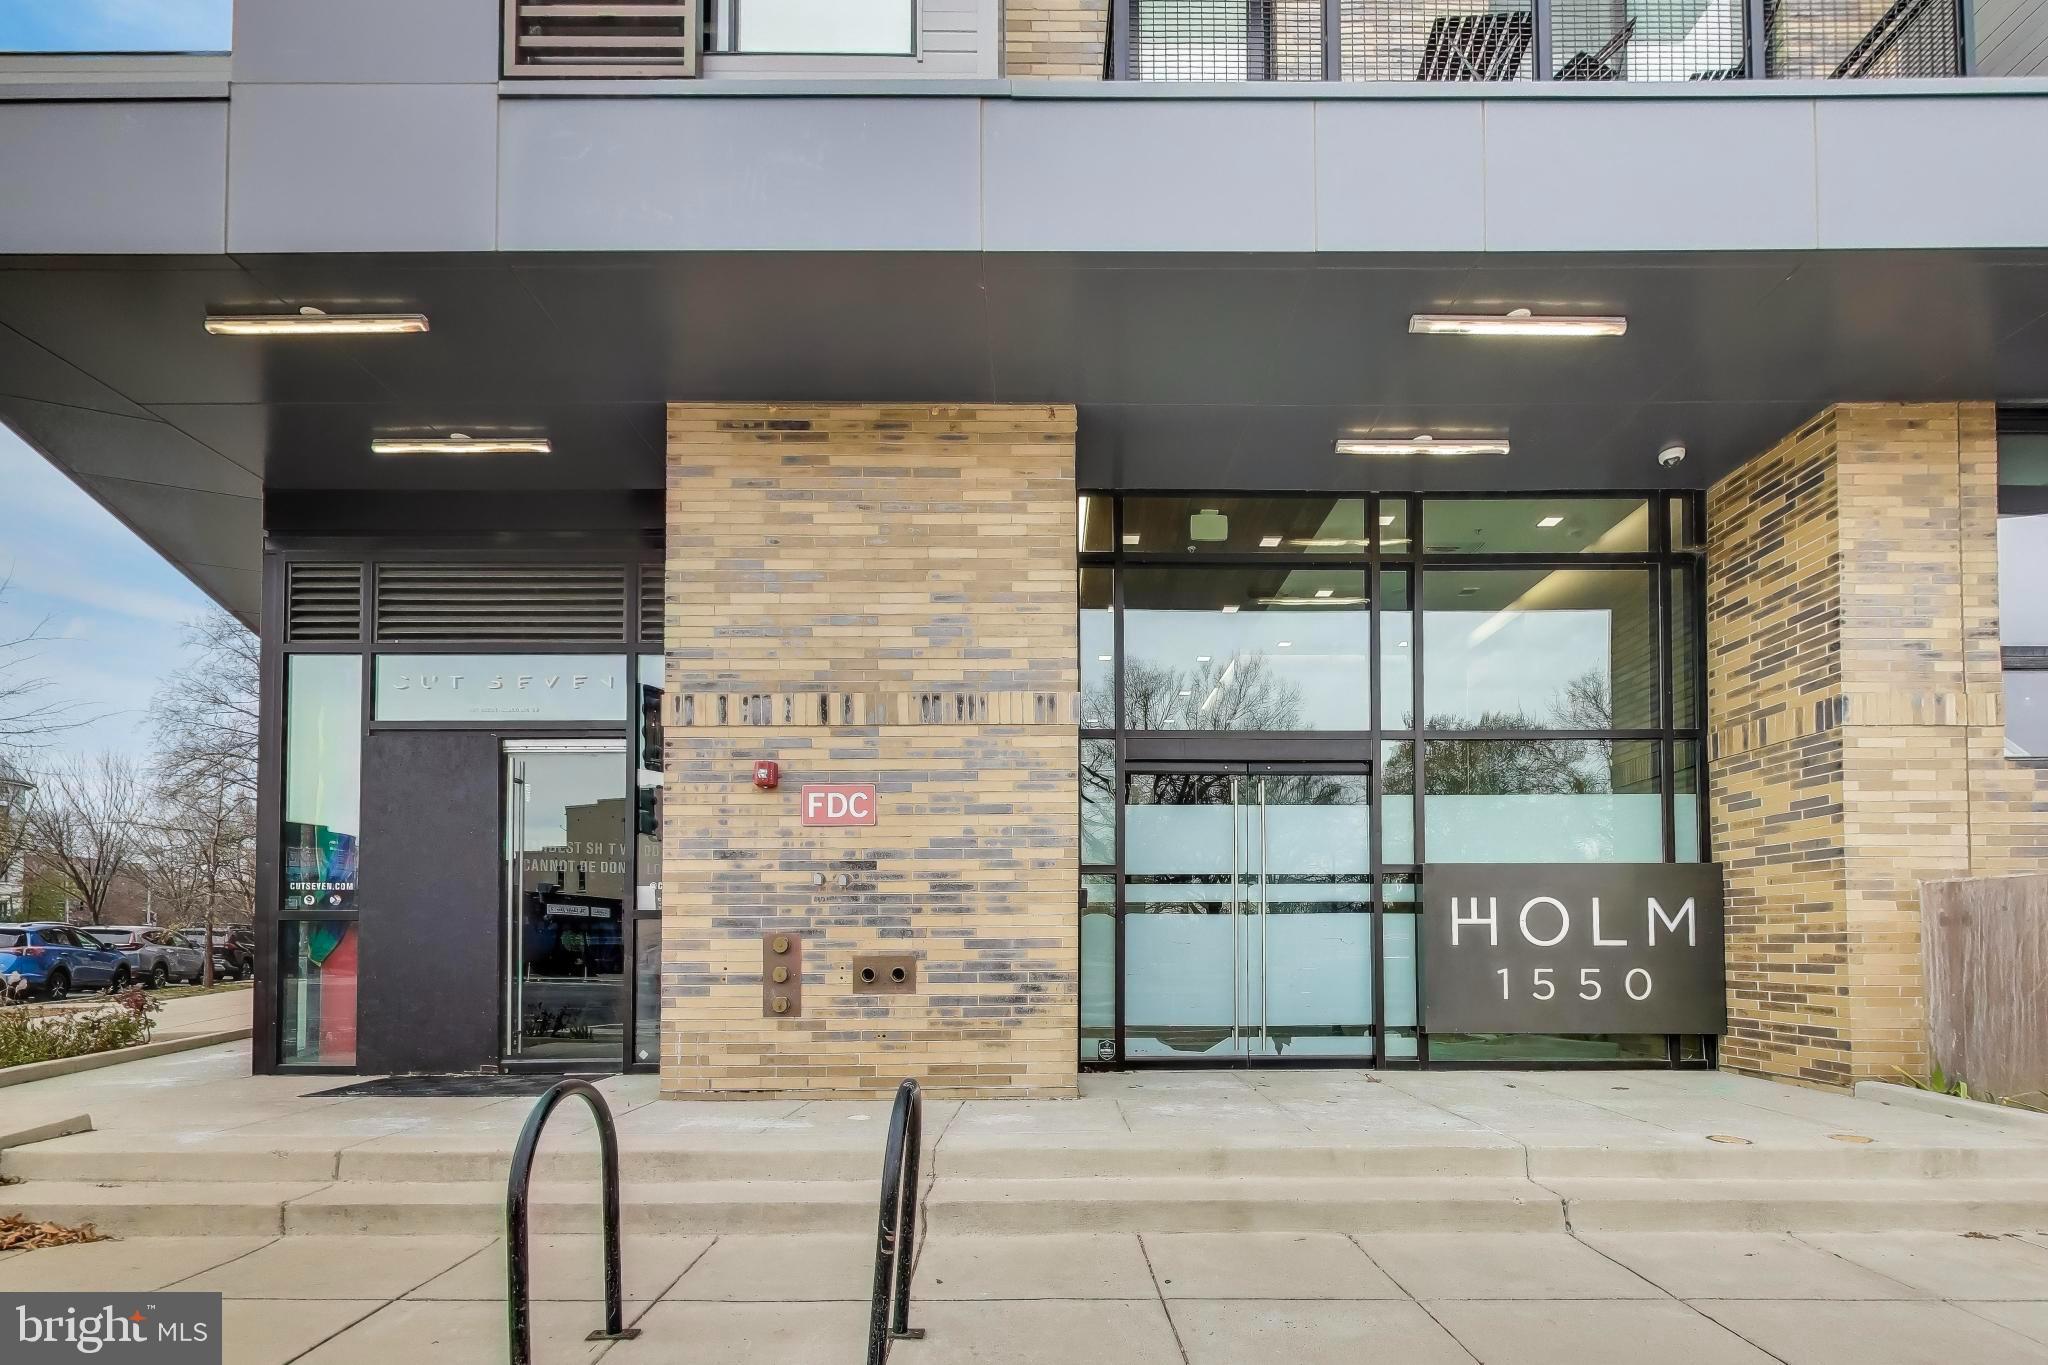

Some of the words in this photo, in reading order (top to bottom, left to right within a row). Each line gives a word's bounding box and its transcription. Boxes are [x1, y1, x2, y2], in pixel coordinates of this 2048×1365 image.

[393, 674, 464, 690] CUT
[488, 674, 615, 690] SEVEN
[808, 792, 869, 818] FDC
[523, 858, 575, 872] CANNOT
[289, 882, 354, 891] CUTSEVEN.COM
[1451, 896, 1696, 947] HOLM
[1497, 968, 1652, 1000] 1550
